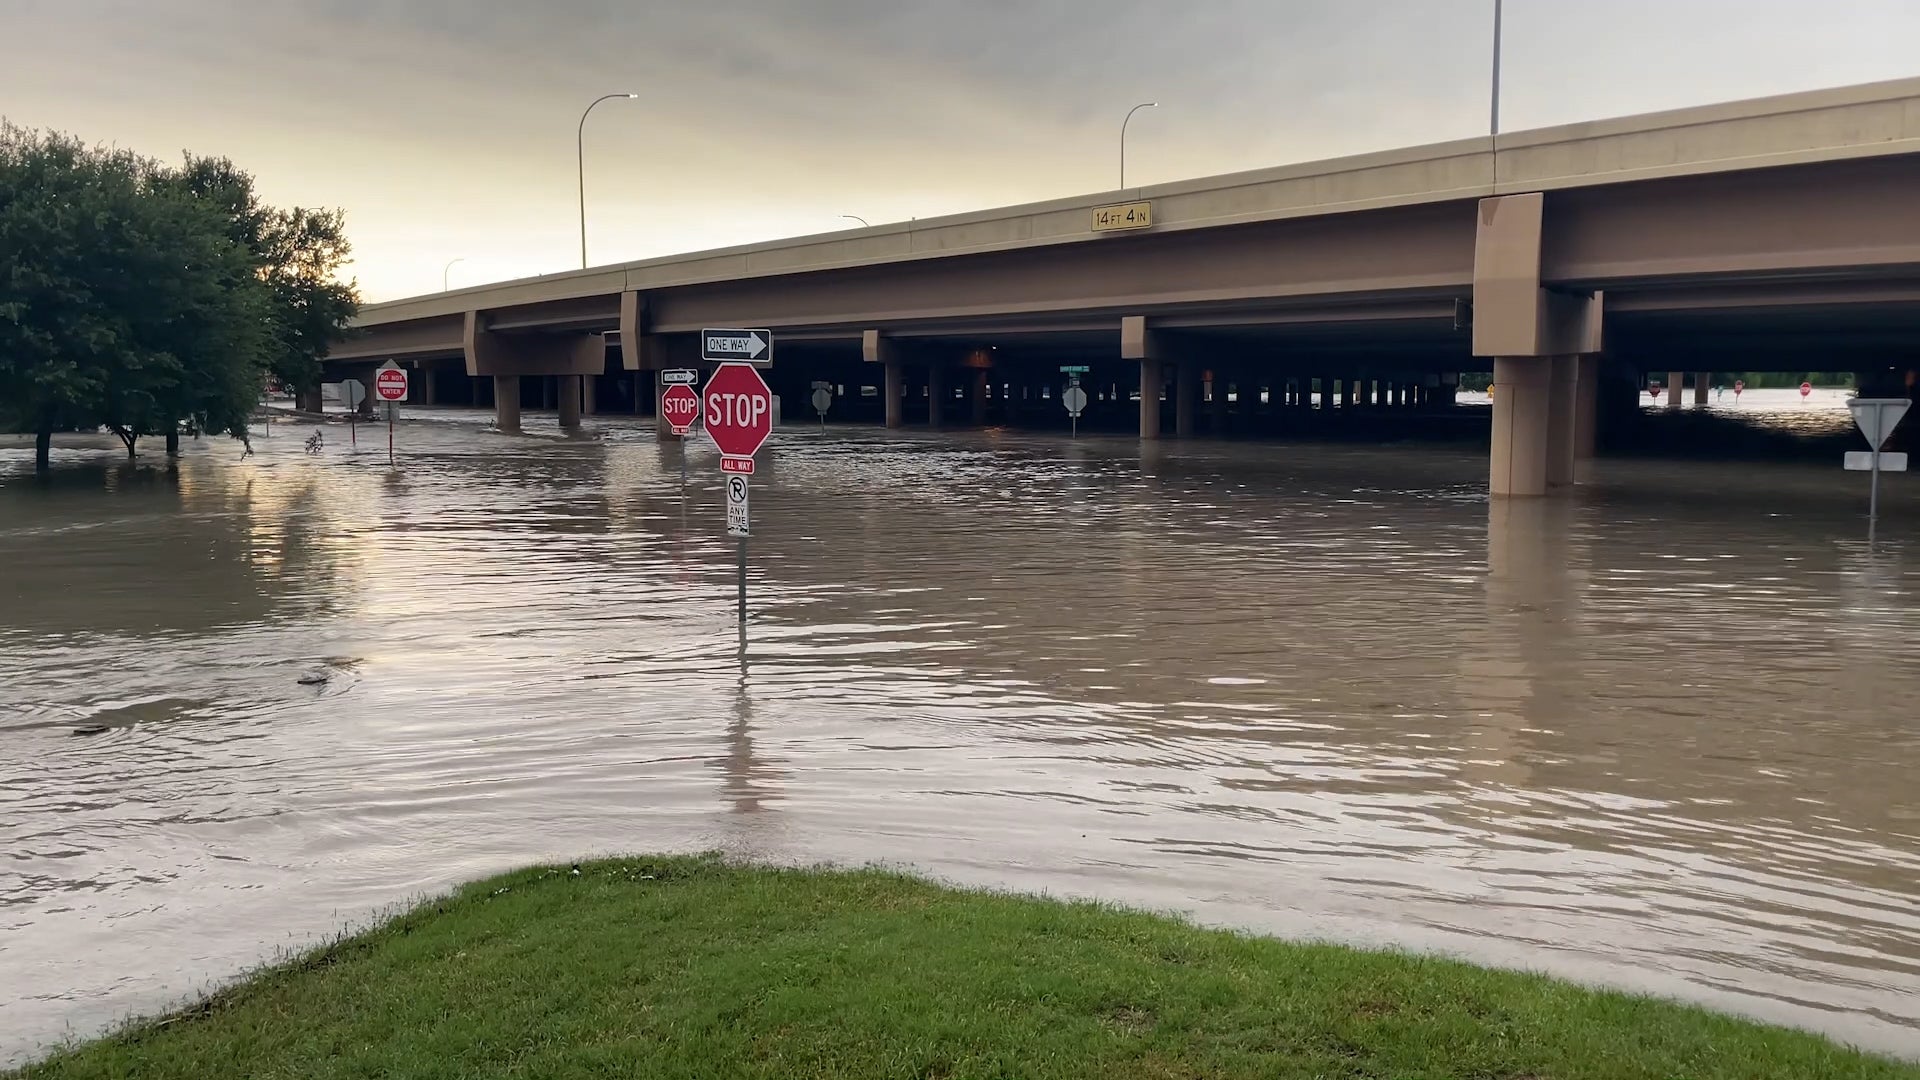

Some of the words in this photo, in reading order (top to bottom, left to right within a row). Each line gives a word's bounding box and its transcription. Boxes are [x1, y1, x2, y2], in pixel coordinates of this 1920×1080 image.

[1097, 211, 1108, 226] 14
[1111, 215, 1121, 224] FT
[1127, 209, 1134, 222] 4
[1137, 212, 1145, 222] IN
[710, 338, 727, 350] ONE
[730, 339, 749, 351] WAY
[665, 398, 696, 414] STOP
[708, 393, 767, 428] STOP
[723, 460, 736, 470] ALL
[737, 461, 751, 471] WAY
[730, 507, 745, 516] ANY
[729, 515, 746, 525] TIME
